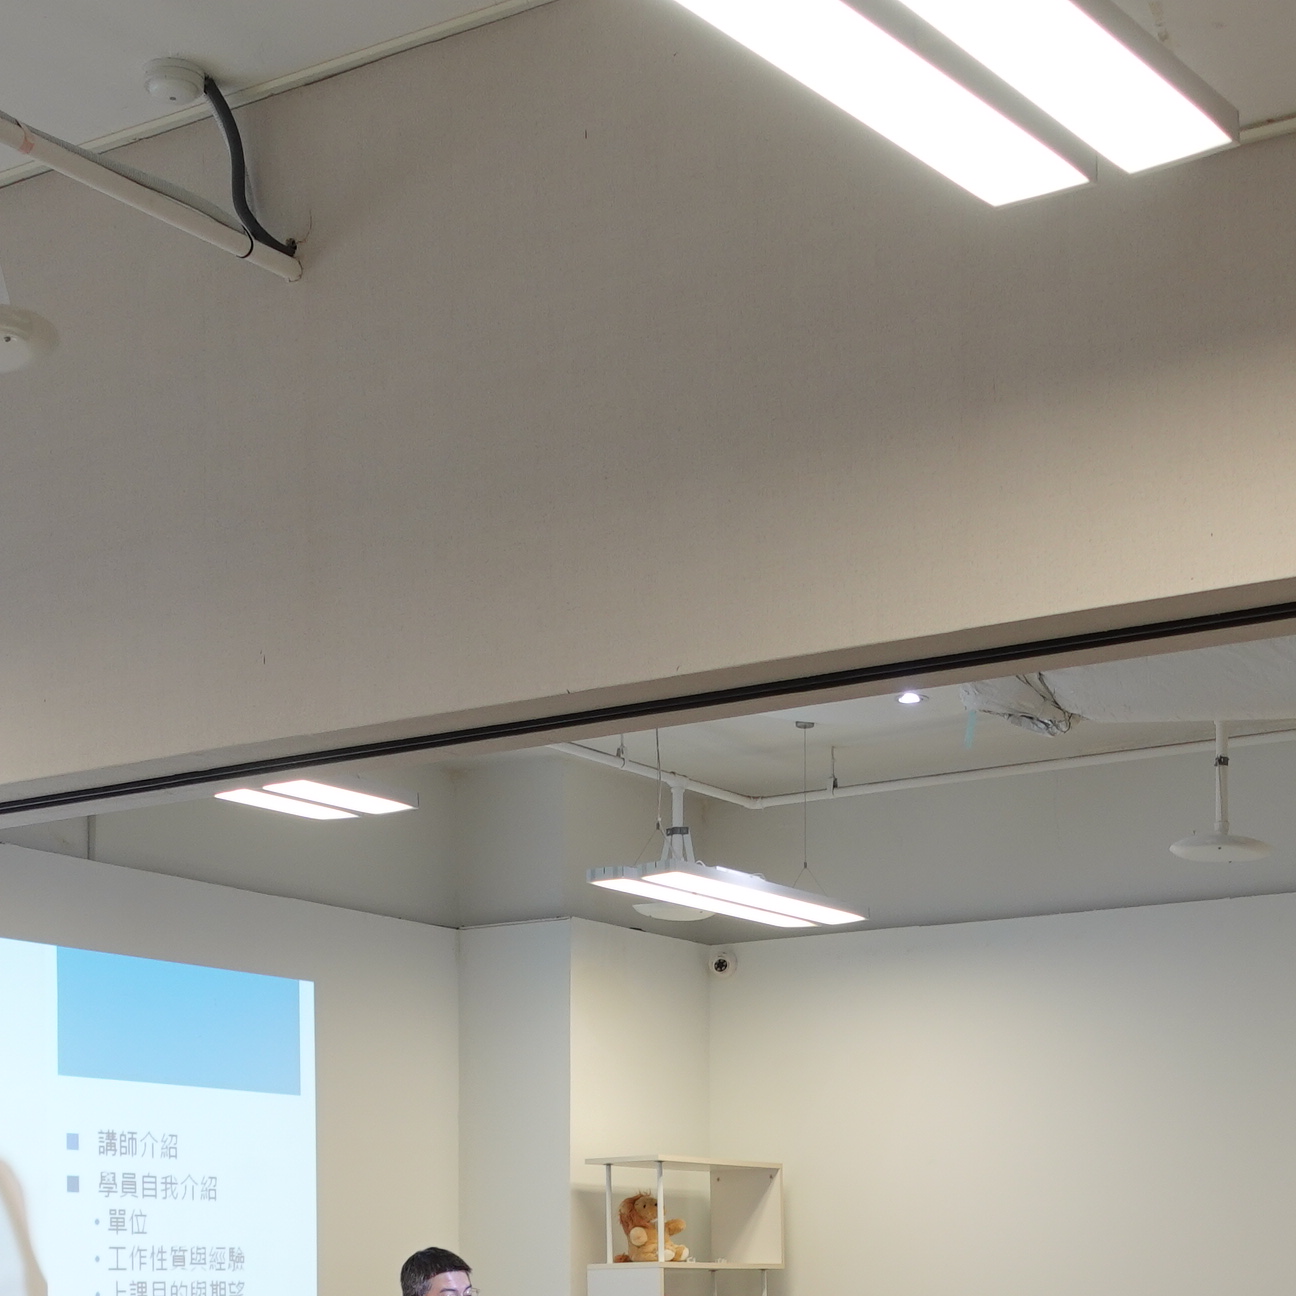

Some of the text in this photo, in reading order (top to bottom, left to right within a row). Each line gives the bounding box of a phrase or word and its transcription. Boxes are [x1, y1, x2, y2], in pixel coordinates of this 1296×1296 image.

[98, 1129, 178, 1159] 講師介紹
[98, 1171, 217, 1201] 學員自我介紹
[108, 1209, 147, 1235] 單位
[108, 1245, 245, 1272] 工作性質與經驗
